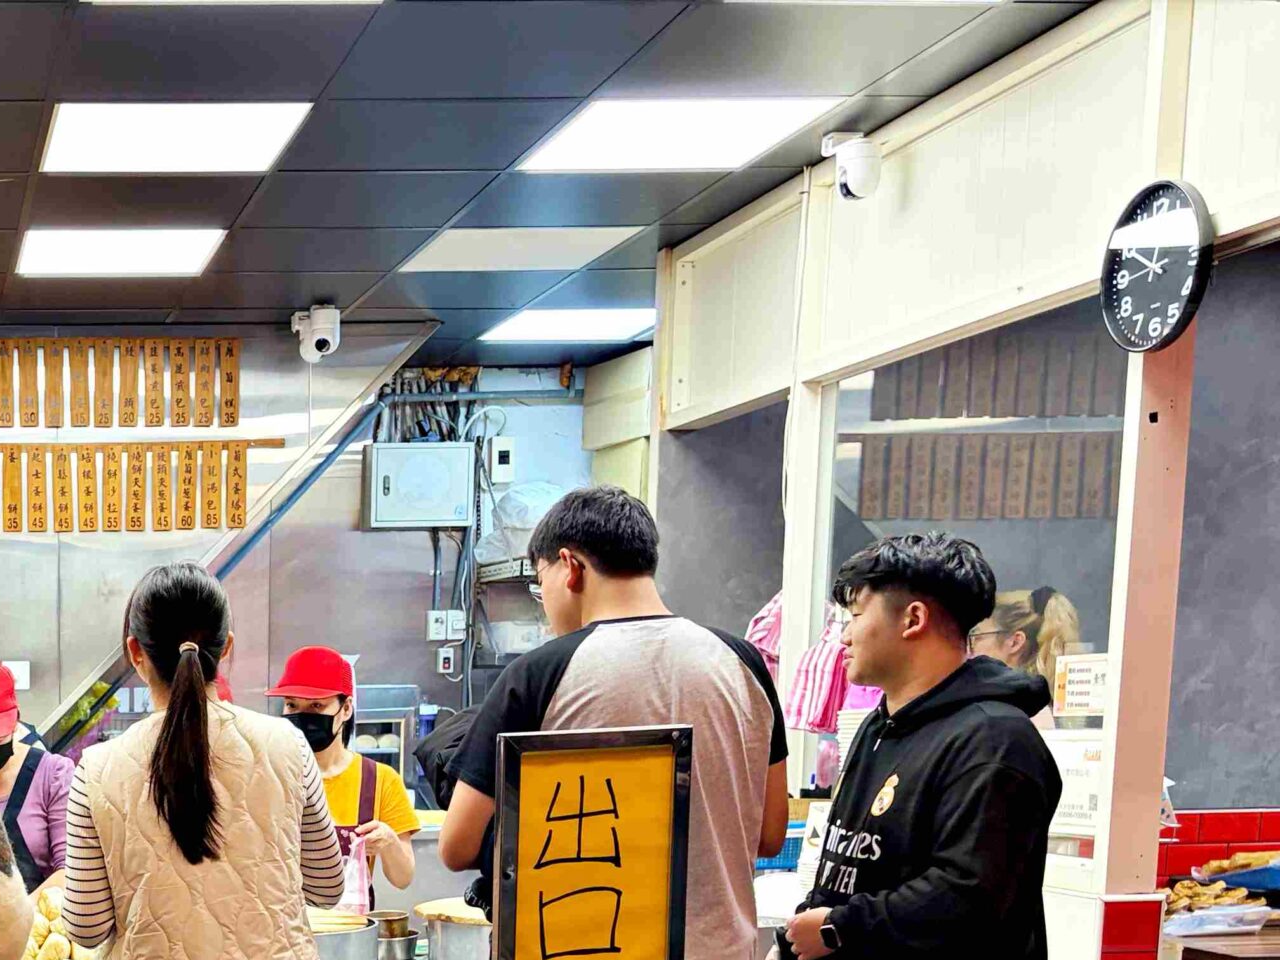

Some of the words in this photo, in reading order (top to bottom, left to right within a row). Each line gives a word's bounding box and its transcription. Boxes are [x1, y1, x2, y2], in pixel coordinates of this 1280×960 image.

[1117, 269, 1129, 290] 9
[1181, 275, 1193, 296] 4
[1120, 296, 1132, 318] 8
[1167, 302, 1180, 324] 5
[1132, 313, 1144, 335] 7
[1148, 317, 1161, 337] 6
[0, 413, 12, 423] 40
[23, 412, 36, 423] 30
[98, 413, 110, 424] 25
[123, 412, 135, 423] 20
[149, 412, 161, 424] 25
[175, 413, 186, 424] 25
[198, 413, 210, 424] 25
[224, 413, 235, 423] 35
[7, 518, 19, 529] 35
[31, 517, 44, 528] 45
[58, 518, 70, 528] 45
[83, 517, 95, 528] 45
[106, 517, 118, 528] 55
[130, 517, 142, 528] 55
[157, 516, 169, 527] 45
[181, 515, 193, 526] 60
[206, 513, 218, 526] 85
[230, 513, 243, 525] 45
[534, 775, 622, 960] 出口
